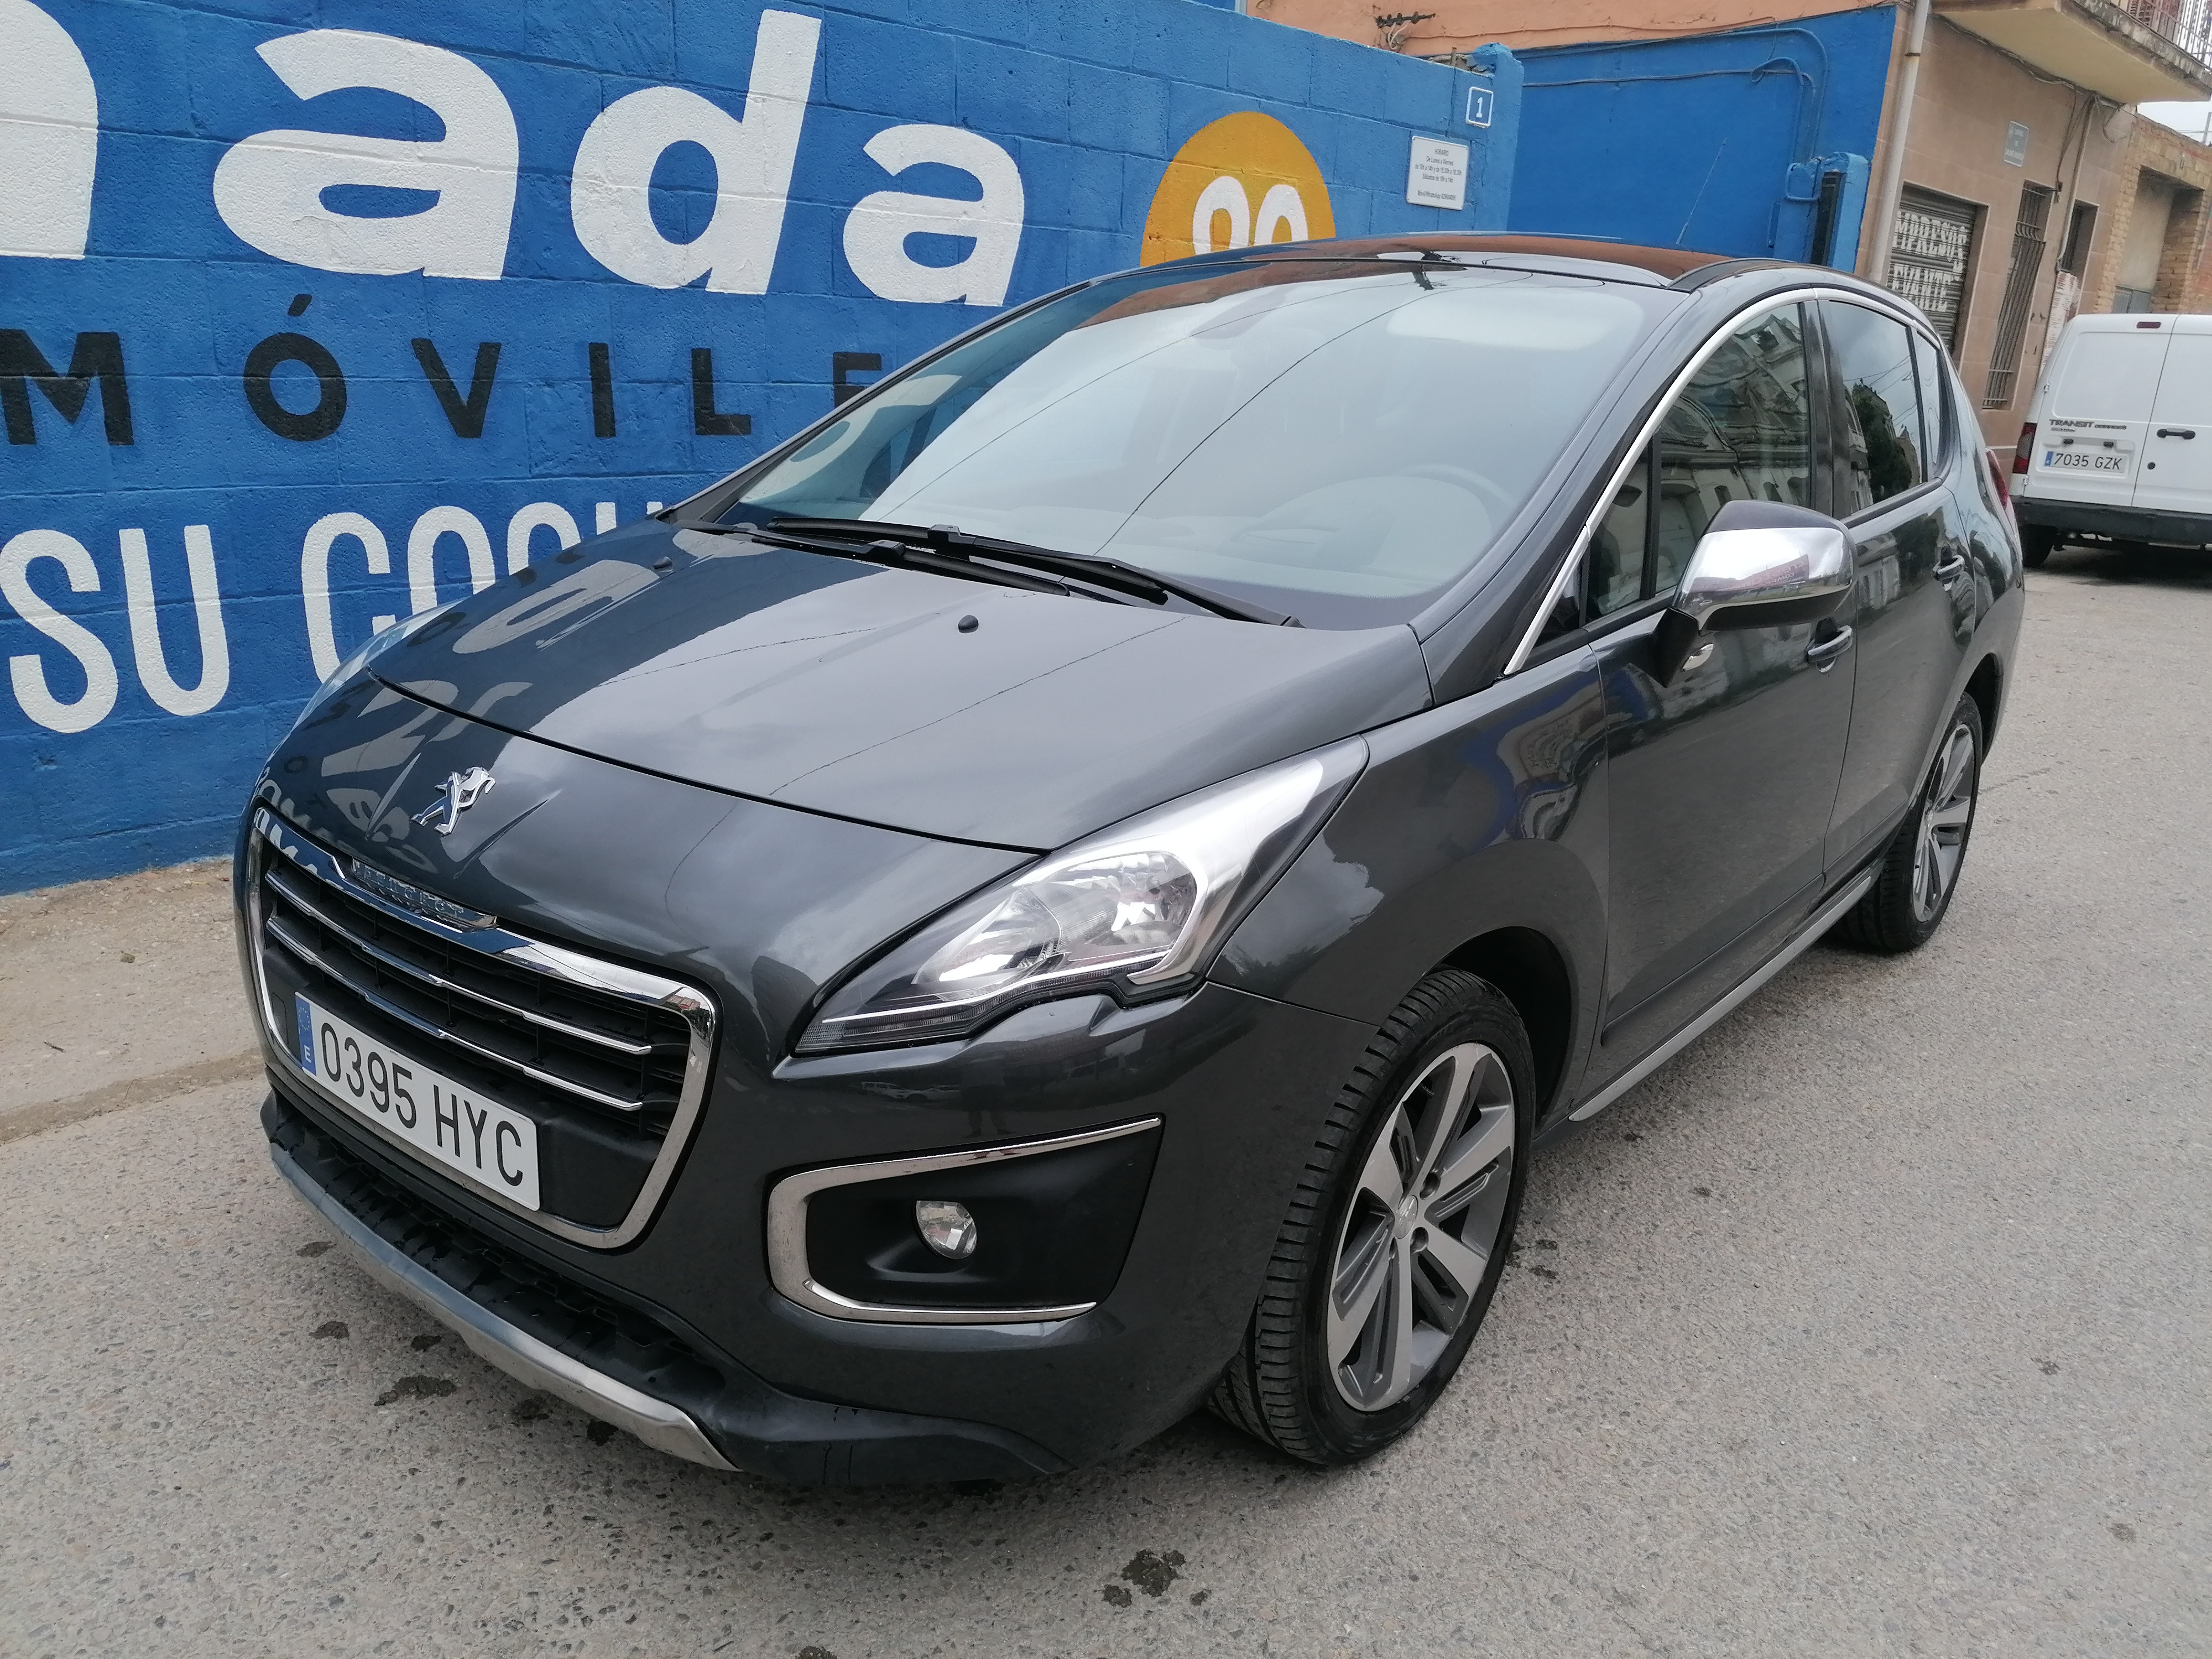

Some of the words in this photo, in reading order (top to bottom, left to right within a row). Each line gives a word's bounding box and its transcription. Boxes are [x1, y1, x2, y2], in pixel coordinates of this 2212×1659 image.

[1475, 96, 1483, 118] 1
[2049, 419, 2094, 427] TRANSIT
[2054, 453, 2089, 467] 7035
[2095, 457, 2122, 469] GZK
[1, 525, 229, 733] SU
[321, 1022, 417, 1129] 0395
[433, 1084, 523, 1187] HYC
